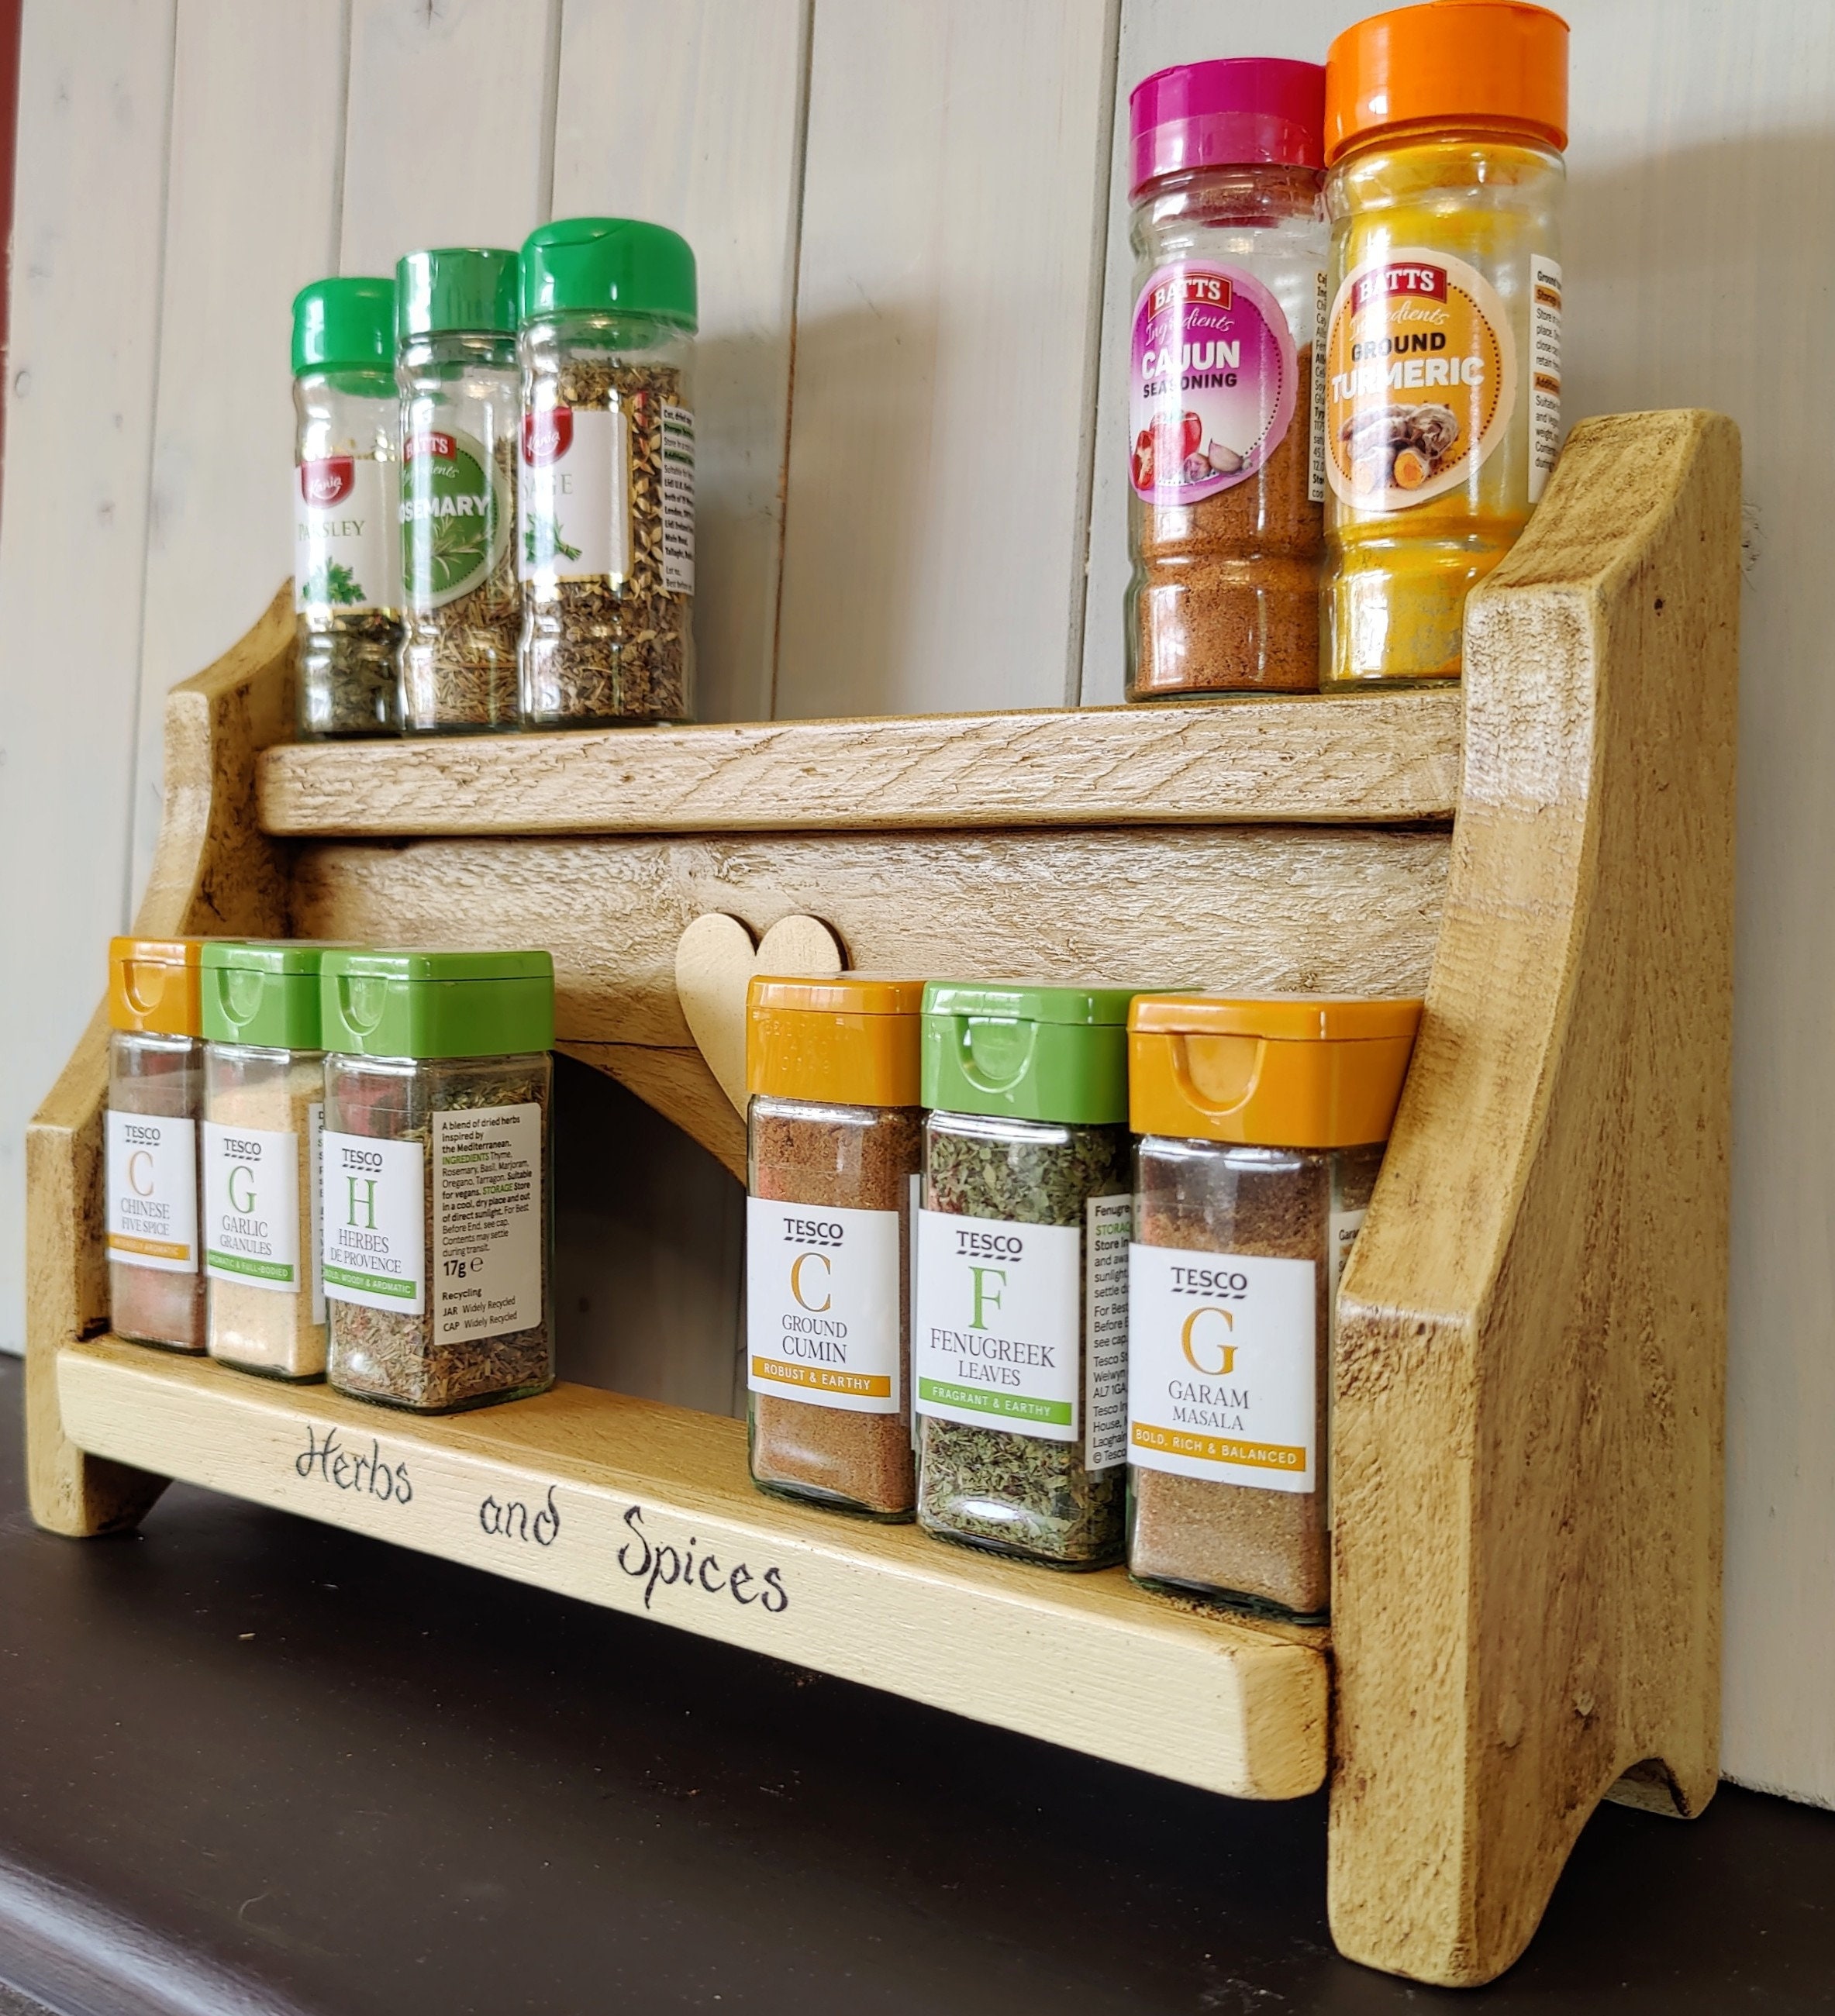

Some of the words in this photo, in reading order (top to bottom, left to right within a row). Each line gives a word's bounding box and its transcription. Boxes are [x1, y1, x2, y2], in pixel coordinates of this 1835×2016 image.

[1360, 268, 1435, 303] BATTS
[1146, 308, 1235, 346] Ingrdients
[1351, 332, 1447, 362] GROUND
[1142, 340, 1240, 380] CAJUN
[1332, 357, 1485, 403] TURMERIC
[405, 436, 449, 459] BTTS
[523, 474, 573, 501] SAE
[398, 495, 490, 523] OSEMARY
[125, 1125, 160, 1140] TESCO
[442, 1122, 448, 1130] A
[450, 1120, 471, 1130] blend
[472, 1118, 480, 1128] of
[481, 1116, 502, 1128] dried
[502, 1115, 521, 1125] herbs
[223, 1138, 262, 1156] TESCO
[442, 1131, 474, 1143] inspired
[475, 1131, 484, 1141] by
[442, 1145, 456, 1154] the
[457, 1139, 512, 1153] Mediterranean.
[342, 1148, 382, 1167] TESCO
[442, 1152, 490, 1165] INGREDIENTS
[129, 1150, 153, 1197] C
[229, 1166, 257, 1214] G
[442, 1191, 454, 1200] for
[482, 1182, 514, 1195] STORAGE
[513, 1180, 530, 1191] Store
[475, 1198, 488, 1208] dry
[488, 1196, 506, 1206] place
[507, 1194, 519, 1203] and
[519, 1192, 531, 1201] out
[121, 1198, 170, 1219] CHINESE
[346, 1176, 378, 1230] H
[1095, 1204, 1130, 1217] Fenugre
[122, 1216, 141, 1232] FIVE
[143, 1220, 170, 1236] SPICE
[222, 1215, 268, 1238] GARLIC
[442, 1214, 450, 1222] of
[451, 1211, 474, 1222] direct
[442, 1225, 467, 1235] Before
[483, 1221, 495, 1229] see
[783, 1218, 843, 1239] TESCO
[1095, 1221, 1130, 1235] STORAG
[219, 1234, 272, 1256] GRANULES
[339, 1229, 389, 1253] HERBES
[442, 1234, 475, 1246] Contents
[956, 1230, 1023, 1254] TESCO
[1095, 1240, 1119, 1251] Store
[330, 1247, 342, 1263] DE
[343, 1250, 402, 1273] PROVENCE
[442, 1246, 466, 1257] during
[1094, 1254, 1112, 1266] and
[1113, 1254, 1129, 1264] awa
[443, 1260, 467, 1278] 17g
[1171, 1266, 1247, 1291] TESCO
[373, 1279, 411, 1294] AROMATIC
[791, 1252, 831, 1313] C
[1094, 1284, 1119, 1298] settle
[442, 1288, 482, 1301] Recycling
[968, 1266, 1007, 1331] F
[443, 1306, 458, 1317] JAR
[462, 1301, 487, 1314] Widely
[488, 1295, 516, 1310] Recycled
[1094, 1305, 1109, 1317] For
[443, 1322, 460, 1332] CAP
[464, 1316, 488, 1328] Widely
[489, 1310, 518, 1324] Recycled
[781, 1314, 847, 1339] GROUND
[1094, 1319, 1123, 1332] Before
[782, 1335, 847, 1364] CUMIN
[930, 1328, 1056, 1368] FENUGREEK
[1094, 1338, 1109, 1349] see
[1181, 1307, 1238, 1375] G
[1093, 1355, 1119, 1367] Tesco
[764, 1363, 805, 1381] ROBUST
[809, 1371, 816, 1384] &
[822, 1373, 871, 1391] EARTHY
[958, 1360, 1021, 1387] LEAVES
[1093, 1370, 1126, 1383] Welwyn
[933, 1385, 989, 1407] FRAGRANT
[992, 1397, 1000, 1409] &
[1005, 1400, 1051, 1417] EARTHY
[1092, 1385, 1109, 1398] AL7
[1168, 1380, 1250, 1409] GARAM
[1092, 1404, 1118, 1417] Tesco
[1172, 1405, 1244, 1432] MASALA
[1093, 1431, 1127, 1448] Laoghair
[1104, 1448, 1127, 1461] Tesco
[1172, 1436, 1202, 1453] RICH
[1207, 1442, 1216, 1454] &
[1221, 1446, 1297, 1465] BALANCED
[295, 1425, 412, 1504] Herbs
[479, 1484, 561, 1547] and
[617, 1505, 788, 1613] Spices
